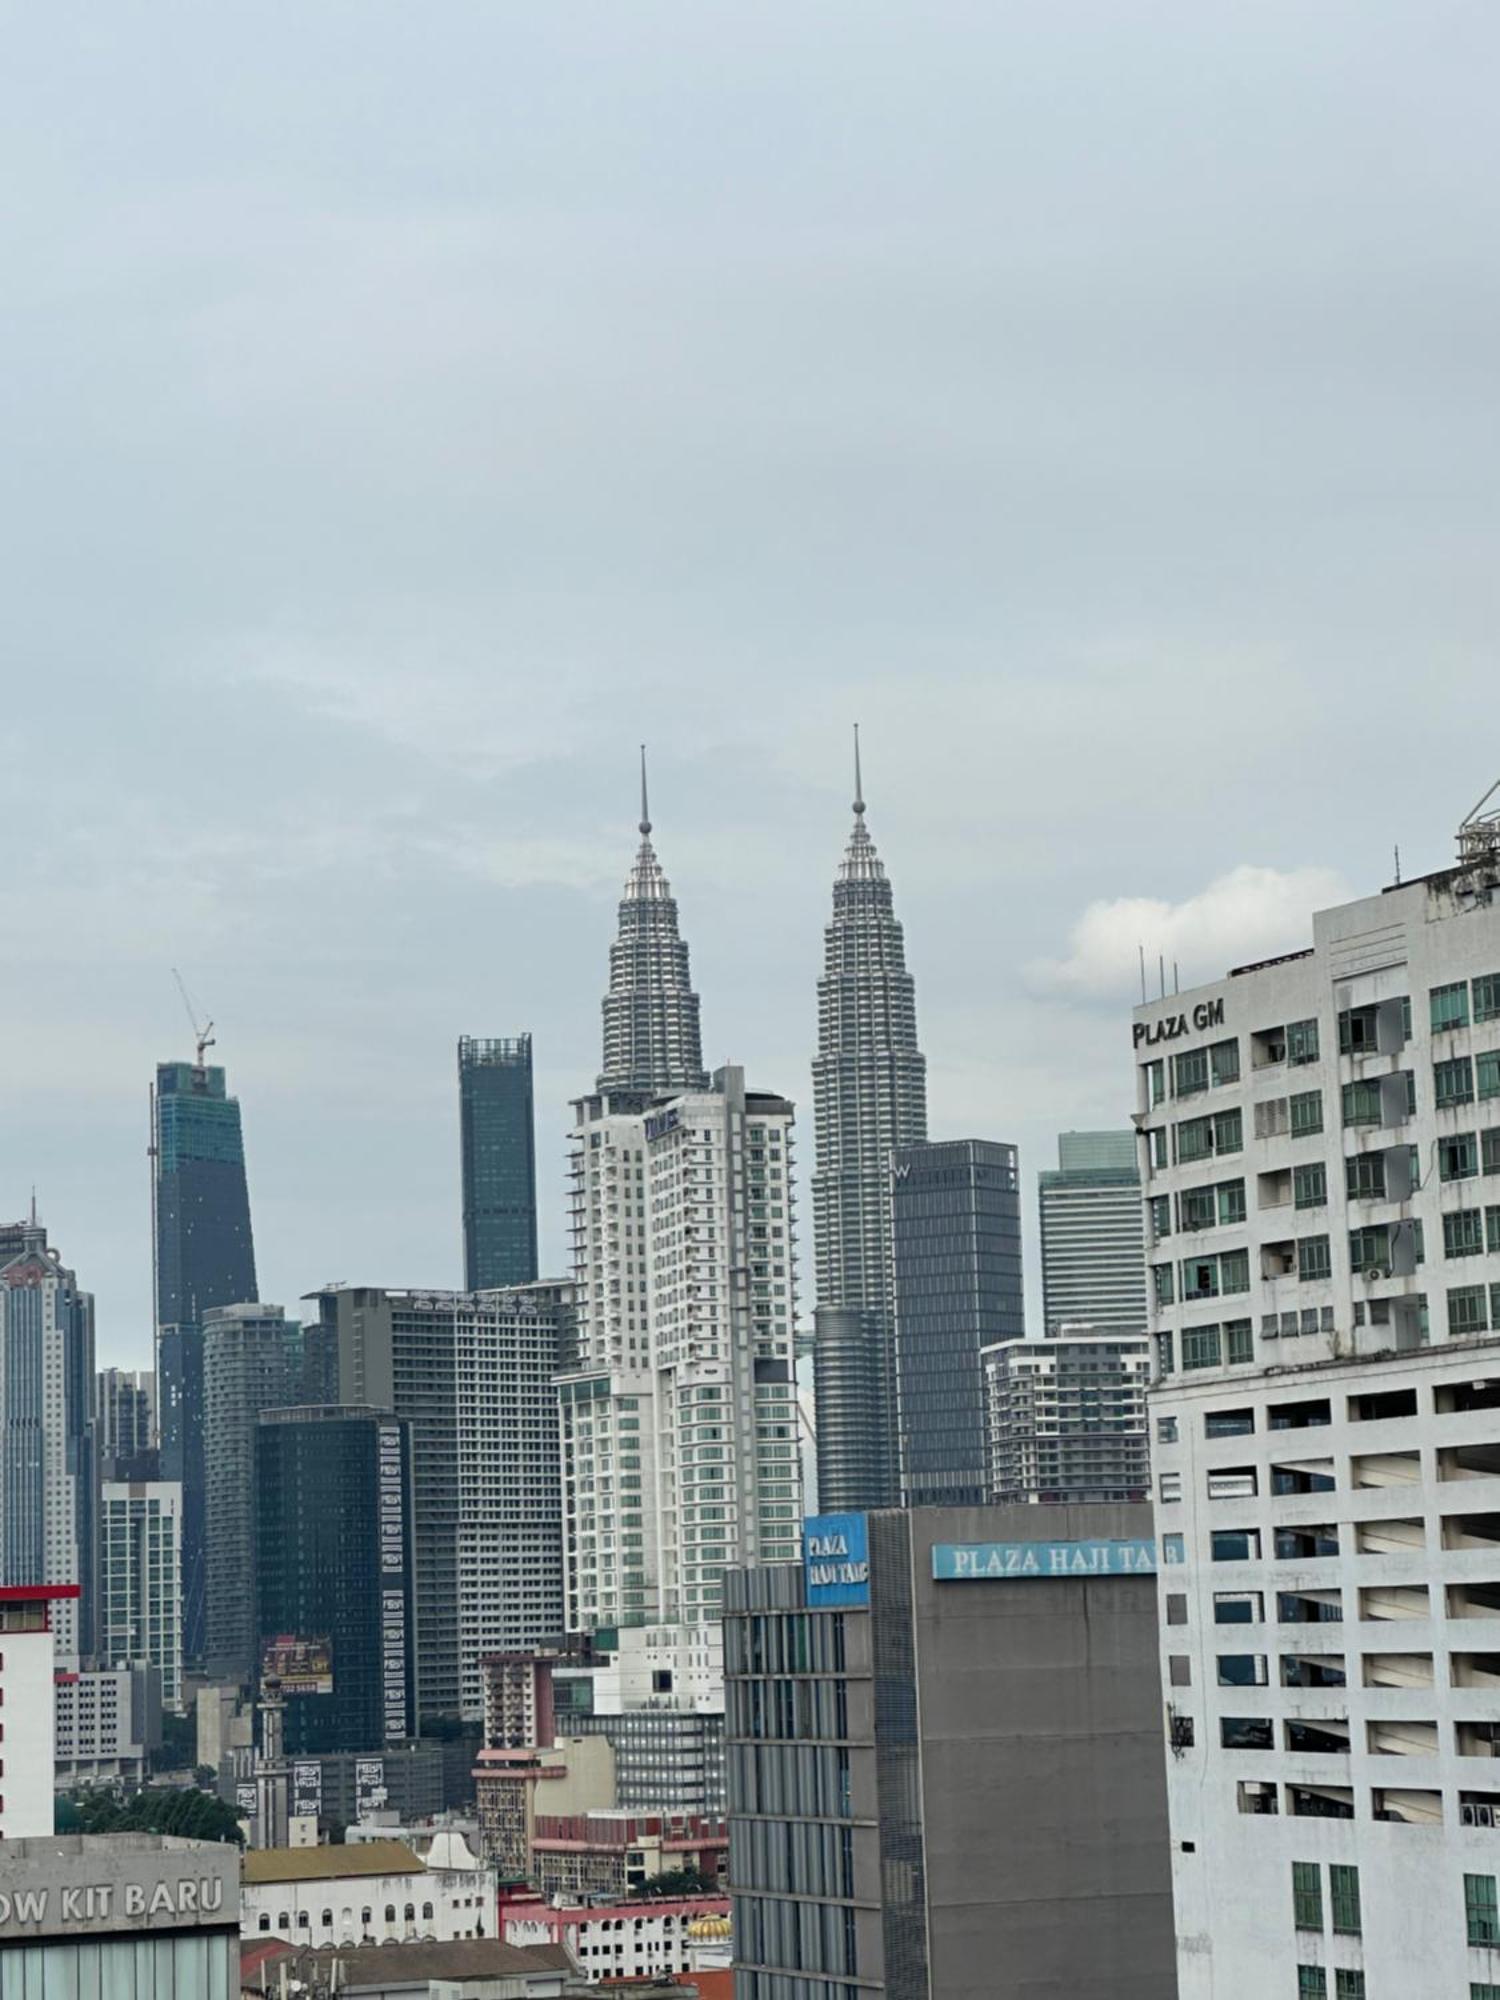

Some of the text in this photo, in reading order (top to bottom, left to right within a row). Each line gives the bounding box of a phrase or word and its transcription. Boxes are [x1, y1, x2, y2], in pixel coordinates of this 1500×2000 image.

[1132, 997, 1225, 1049] PLAZA GM
[954, 1549, 1039, 1573] PLAZA
[1050, 1548, 1109, 1570] HAJI
[62, 1885, 113, 1921] KIT
[125, 1877, 221, 1916] BARU
